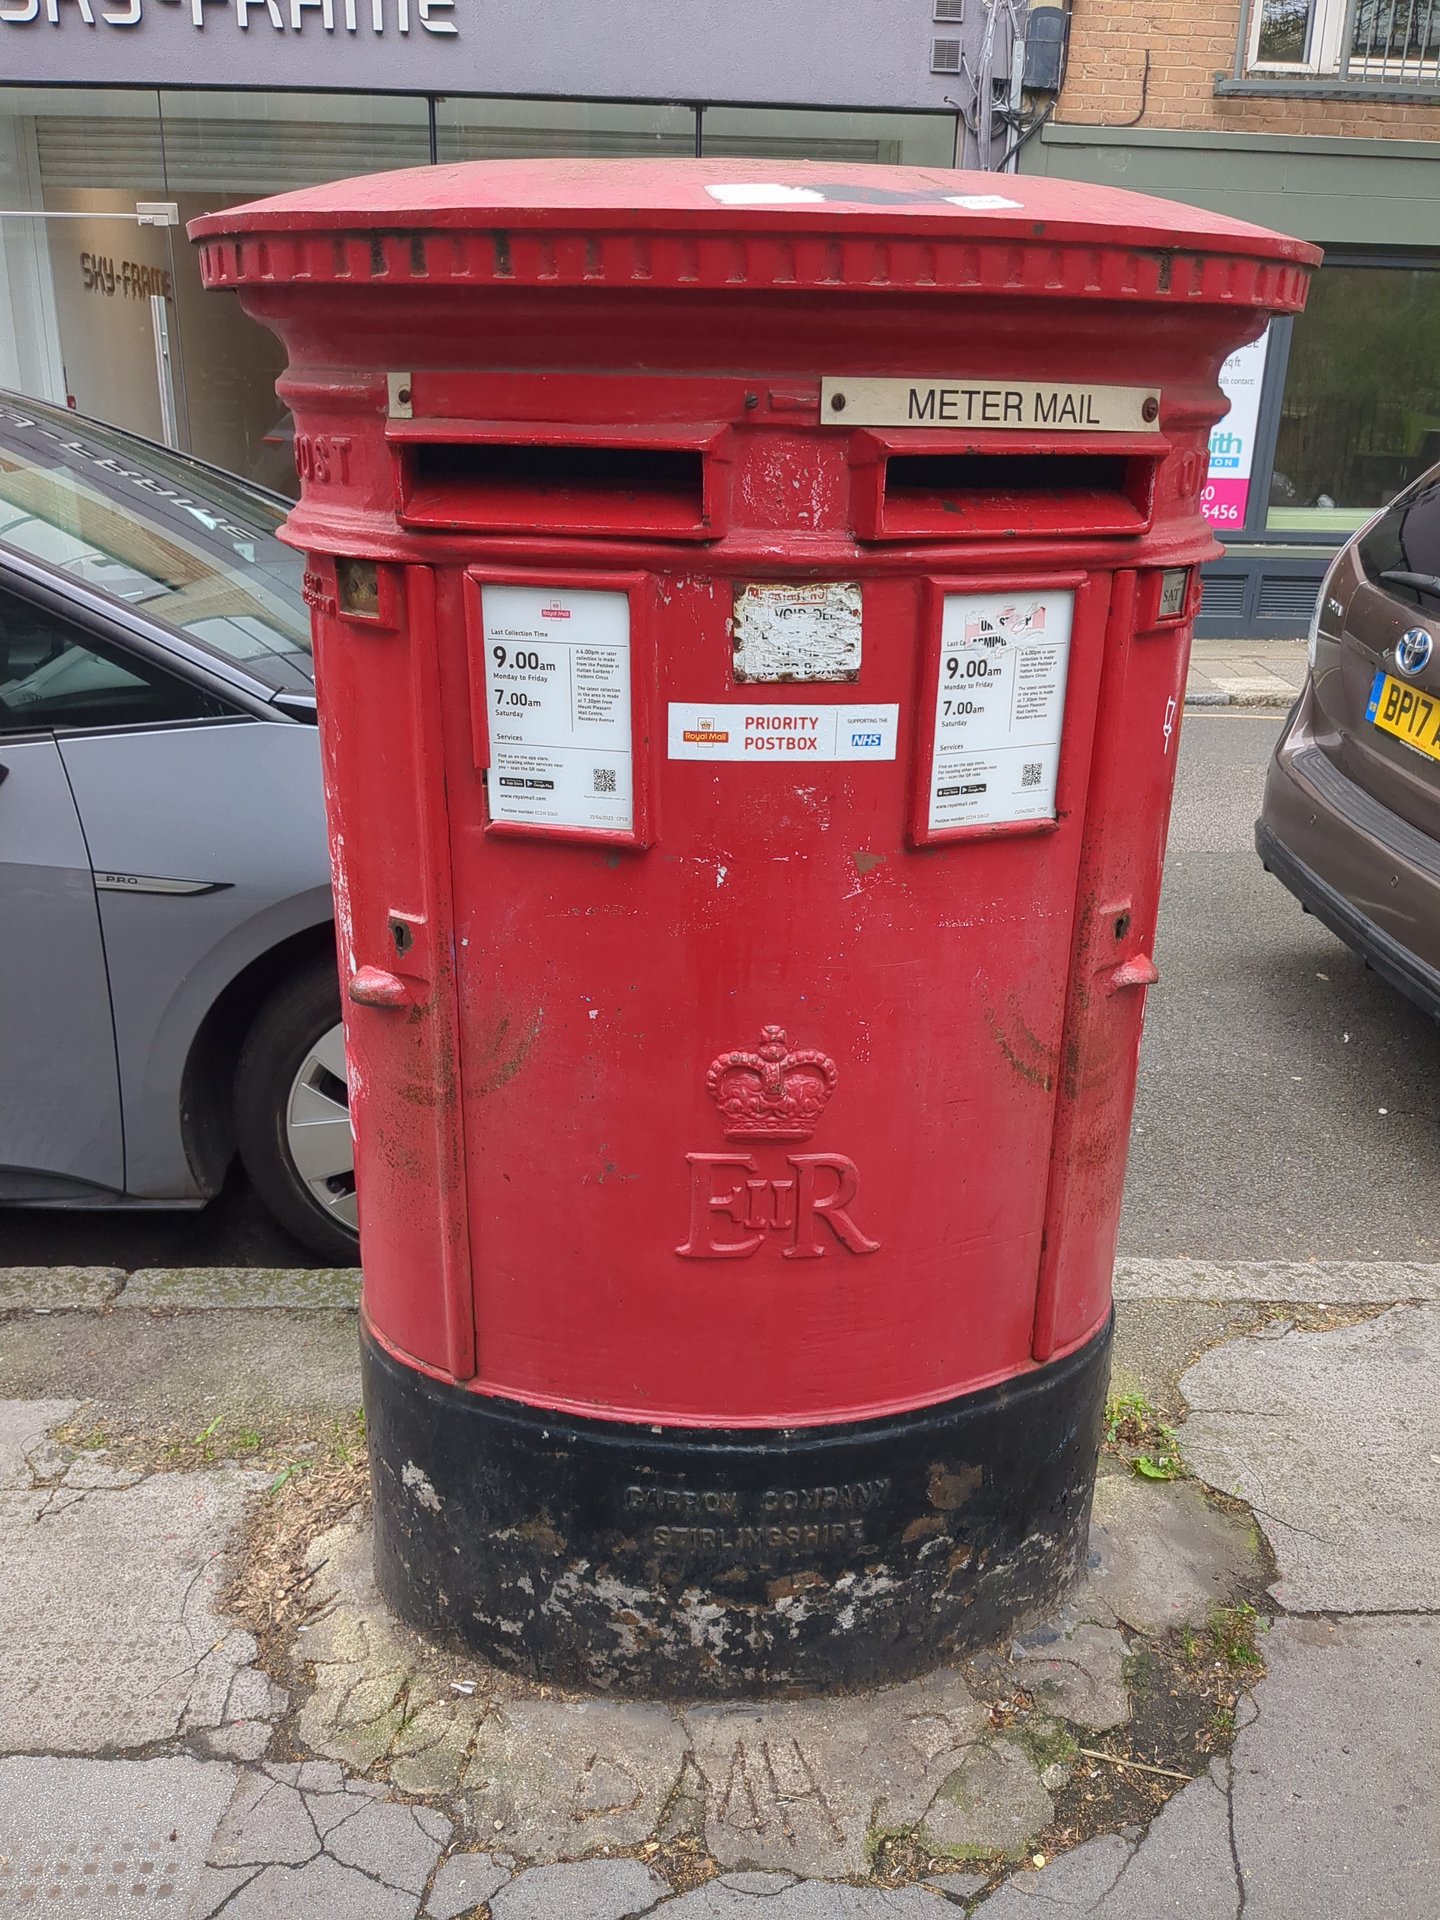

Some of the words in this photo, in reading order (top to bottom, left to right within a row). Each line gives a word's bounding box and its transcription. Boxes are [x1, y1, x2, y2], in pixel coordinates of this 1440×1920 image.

[80, 252, 173, 304] SKY-FRAME
[908, 388, 1023, 421] METER
[1034, 392, 1100, 424] MAIL
[1163, 588, 1180, 602] SAT
[493, 646, 555, 671] 9.00am
[947, 658, 1001, 679] 9.00am
[944, 683, 967, 691] Monday
[494, 689, 541, 707] 7.00am
[496, 710, 523, 718] Saturday
[943, 700, 984, 716] 7.00am
[1383, 683, 1434, 738] BP17
[745, 716, 818, 730] PRIORITY
[941, 720, 967, 728] Saturday
[496, 733, 523, 741] Services
[686, 732, 708, 742] Royal
[708, 732, 727, 740] Mail
[745, 737, 818, 750] POSTBOX
[852, 734, 880, 746] NHS
[106, 876, 138, 884] PRO
